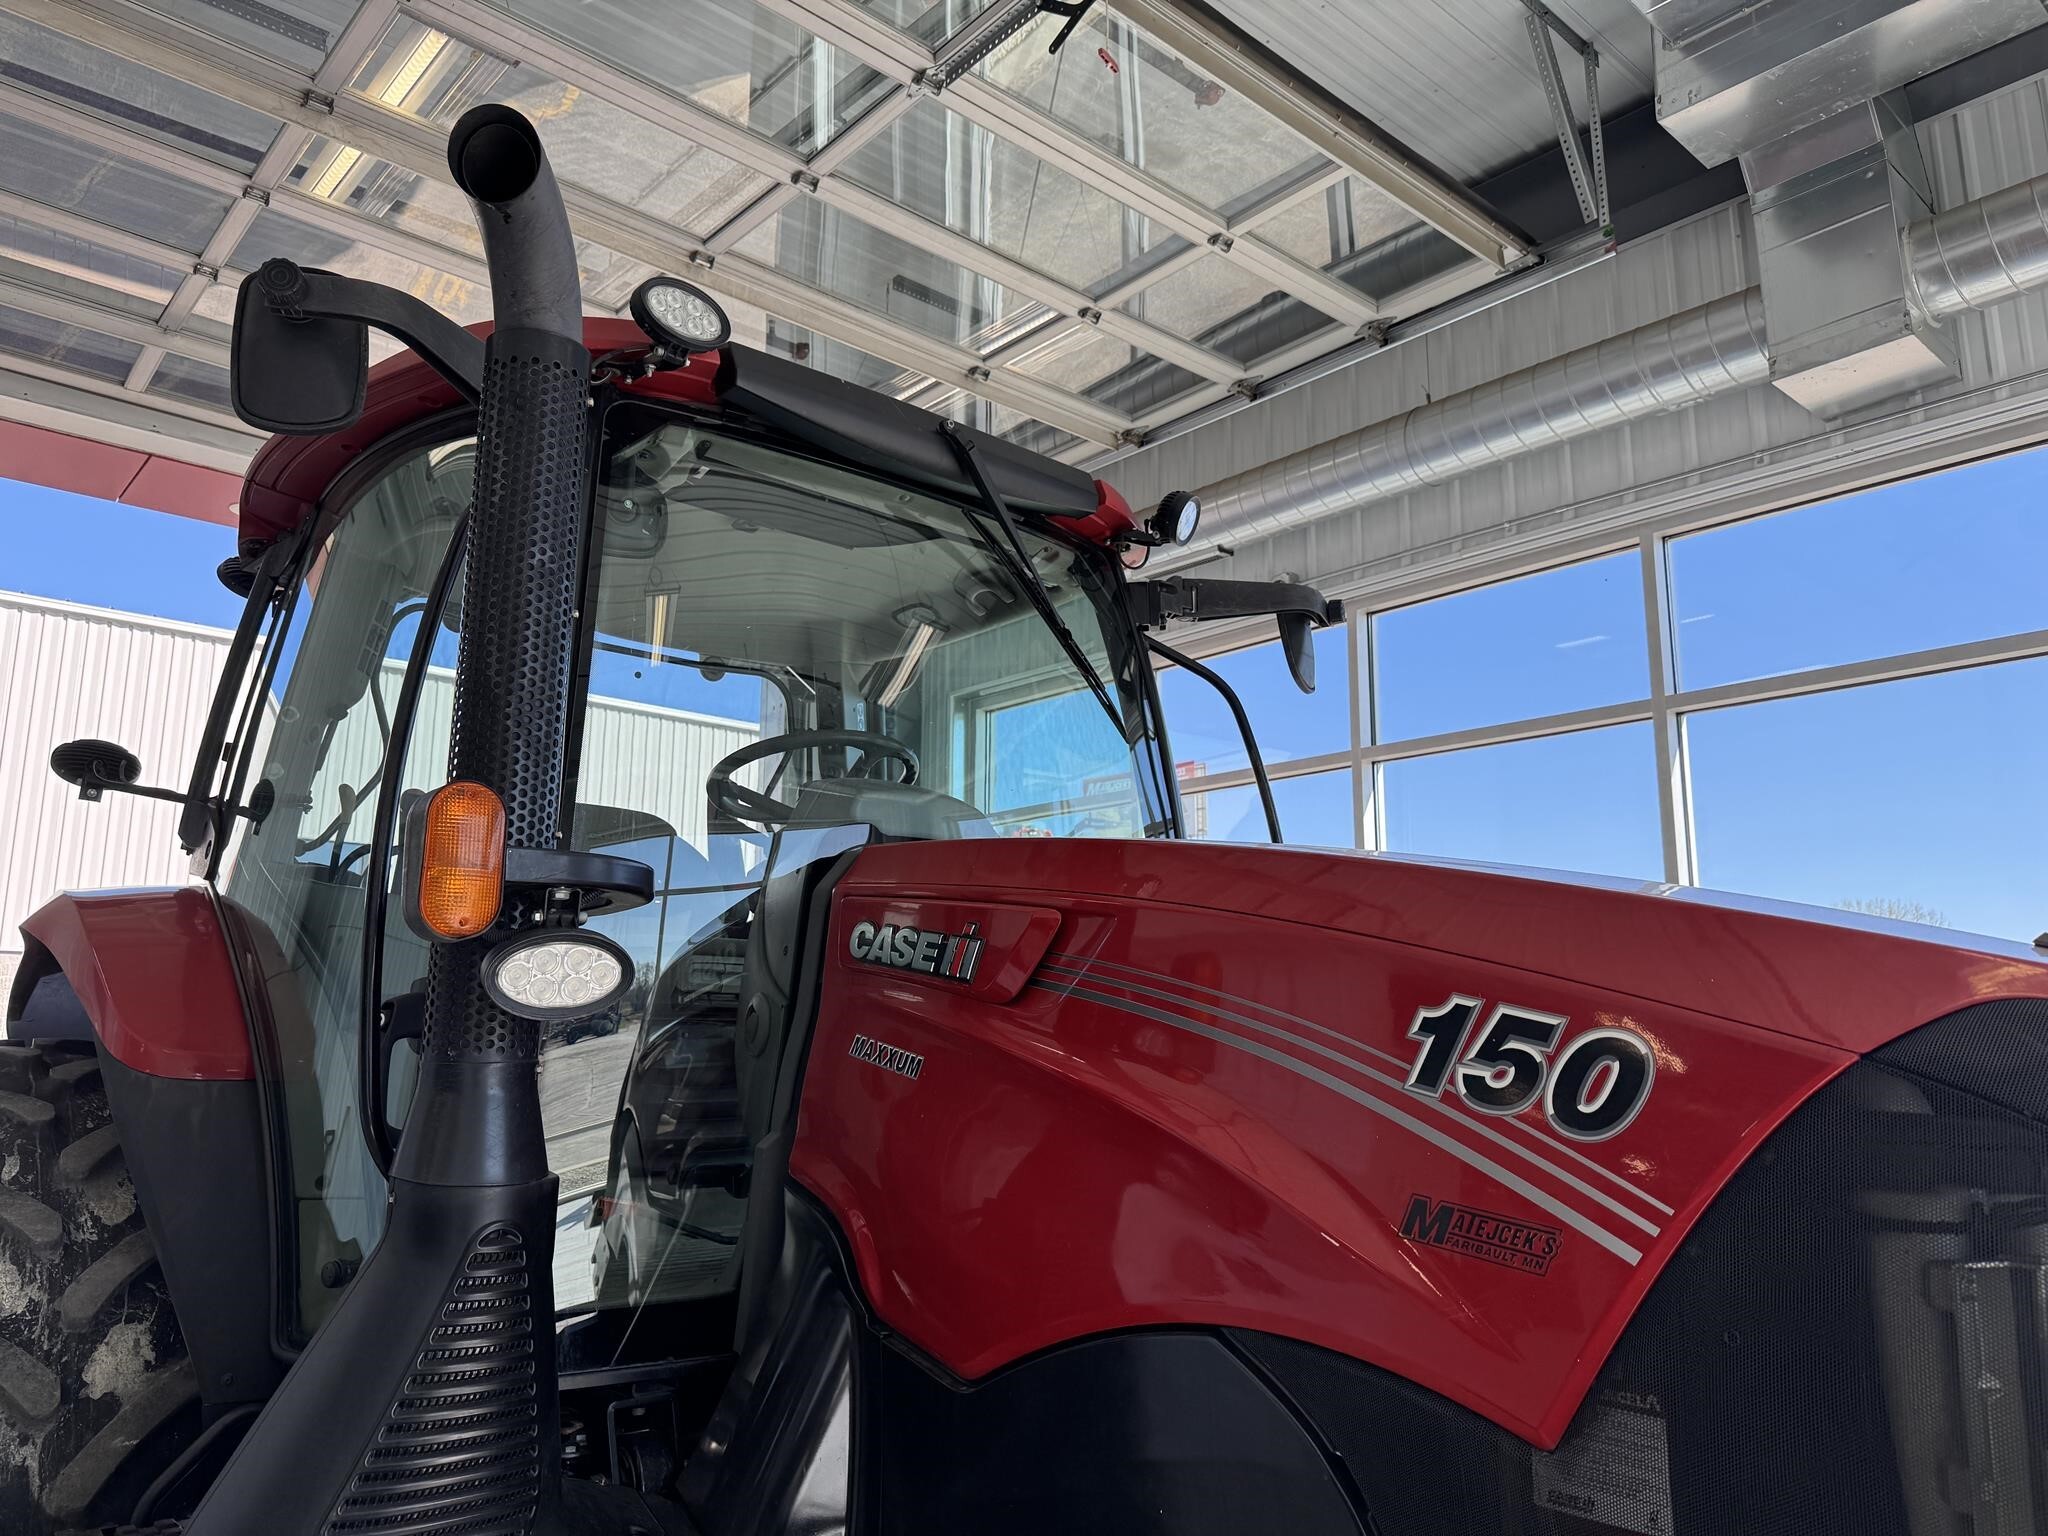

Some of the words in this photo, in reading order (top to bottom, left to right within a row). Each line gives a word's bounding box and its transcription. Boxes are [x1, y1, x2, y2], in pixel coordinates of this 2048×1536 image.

[849, 919, 944, 973] CASE
[849, 1033, 925, 1080] MAXXUM
[1403, 992, 1657, 1142] 150
[1402, 1198, 1558, 1255] MATEJCEK'S
[1445, 1236, 1518, 1265] FARIBAULT,
[1521, 1257, 1546, 1271] MN
